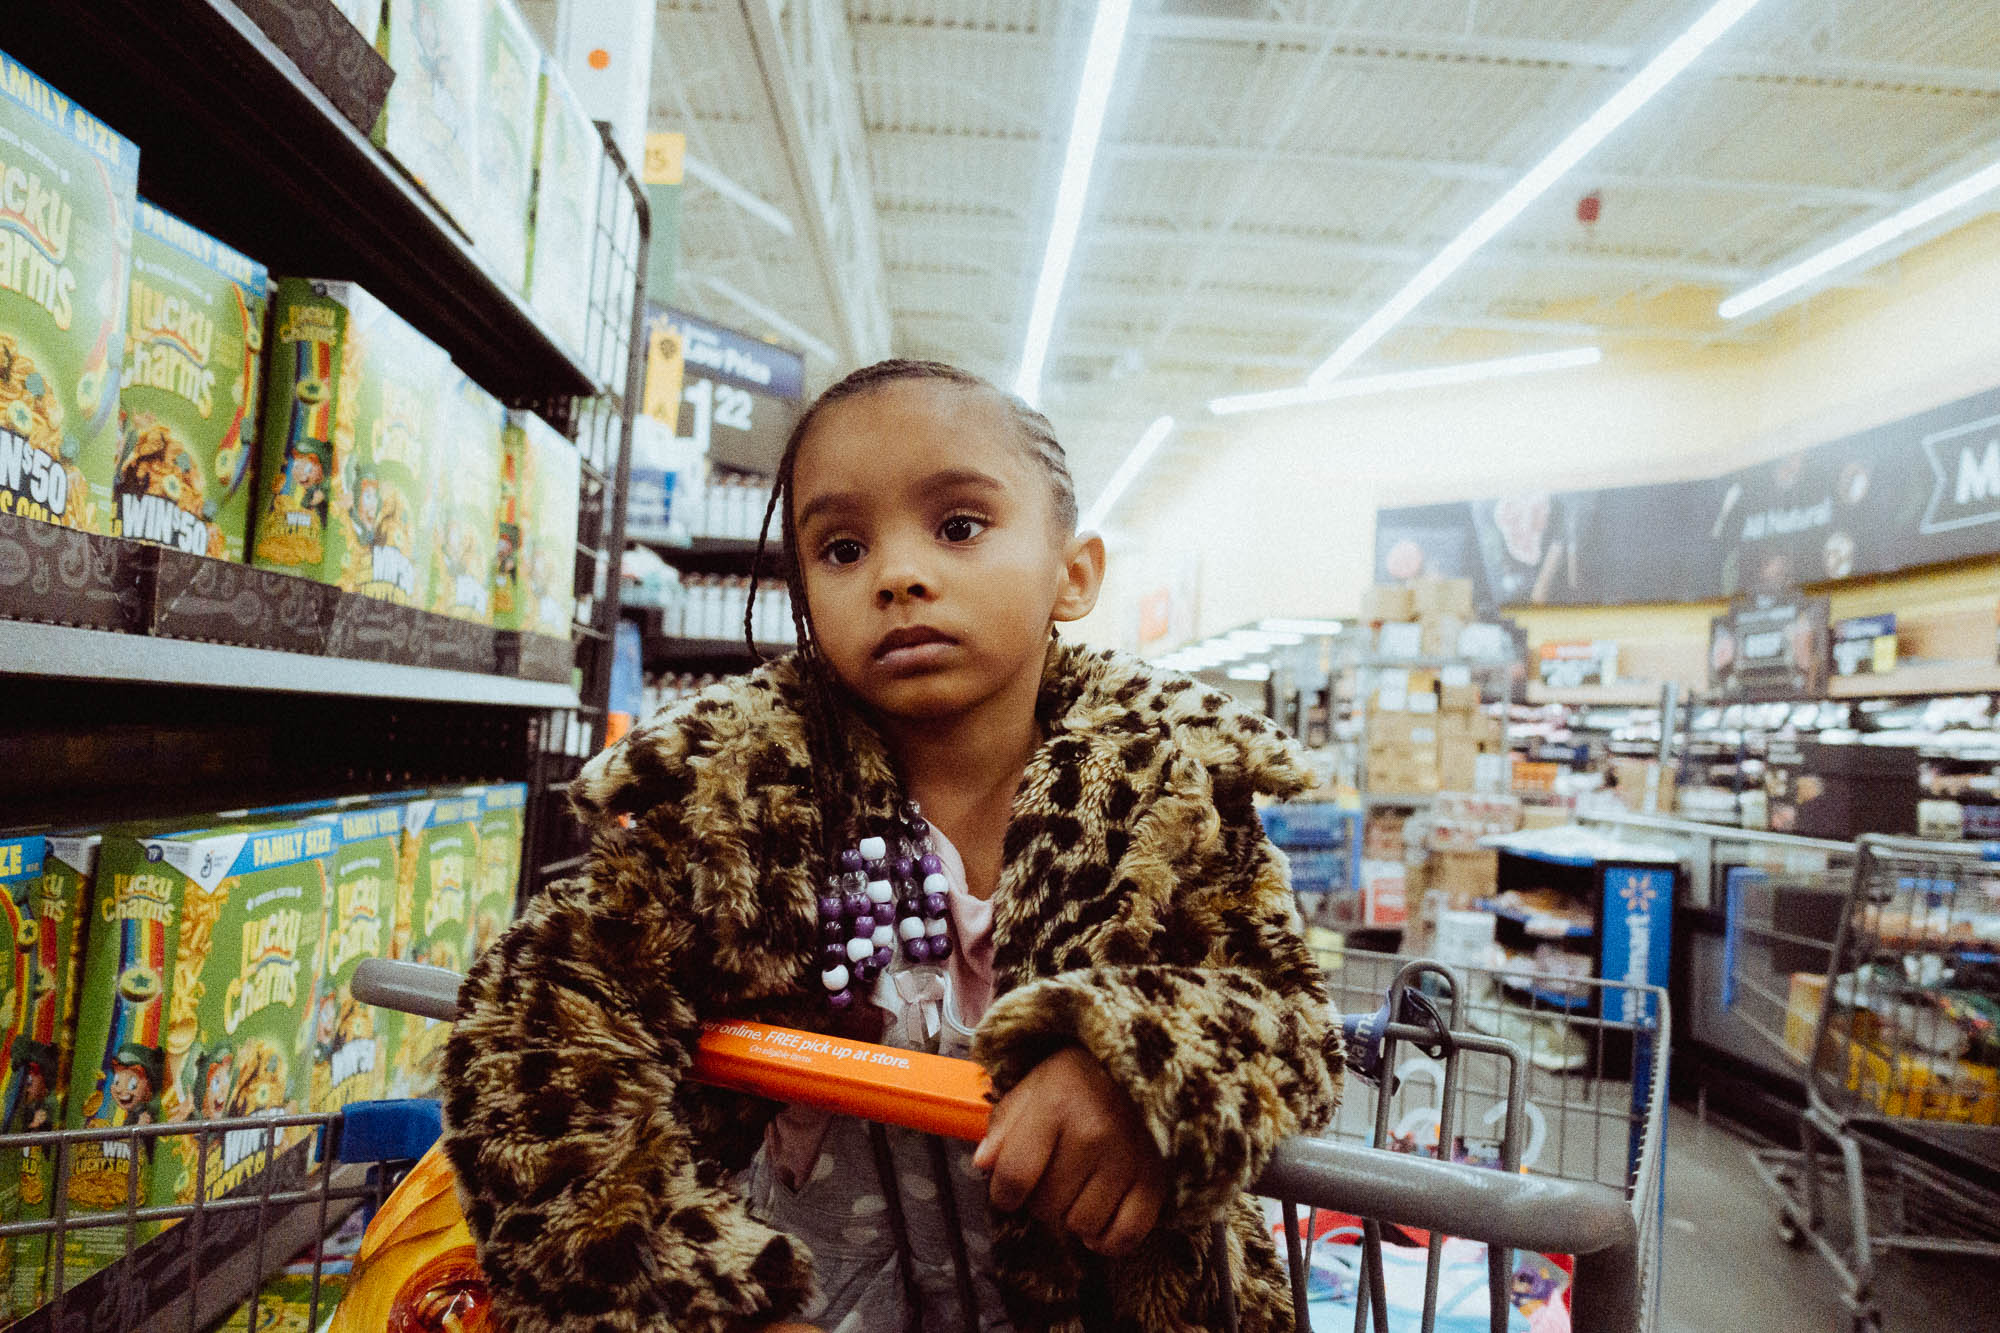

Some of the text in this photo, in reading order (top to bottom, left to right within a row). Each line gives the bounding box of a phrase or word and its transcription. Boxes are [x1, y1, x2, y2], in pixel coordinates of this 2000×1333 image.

[0, 55, 69, 128] AMILY
[74, 109, 121, 165] SIZE
[0, 162, 72, 266] cky
[0, 845, 22, 878] ZE
[253, 834, 303, 867] FAMILY
[305, 828, 332, 856] SIZE
[113, 874, 174, 901] Lucky
[101, 896, 175, 928] Charms
[242, 907, 303, 975] Lucky
[224, 958, 301, 1036] Charms
[720, 1024, 762, 1041] online.
[764, 1031, 803, 1048] FREE
[798, 1039, 832, 1055] pick
[831, 1045, 853, 1060] up
[852, 1049, 870, 1061] at
[869, 1052, 910, 1070] store.
